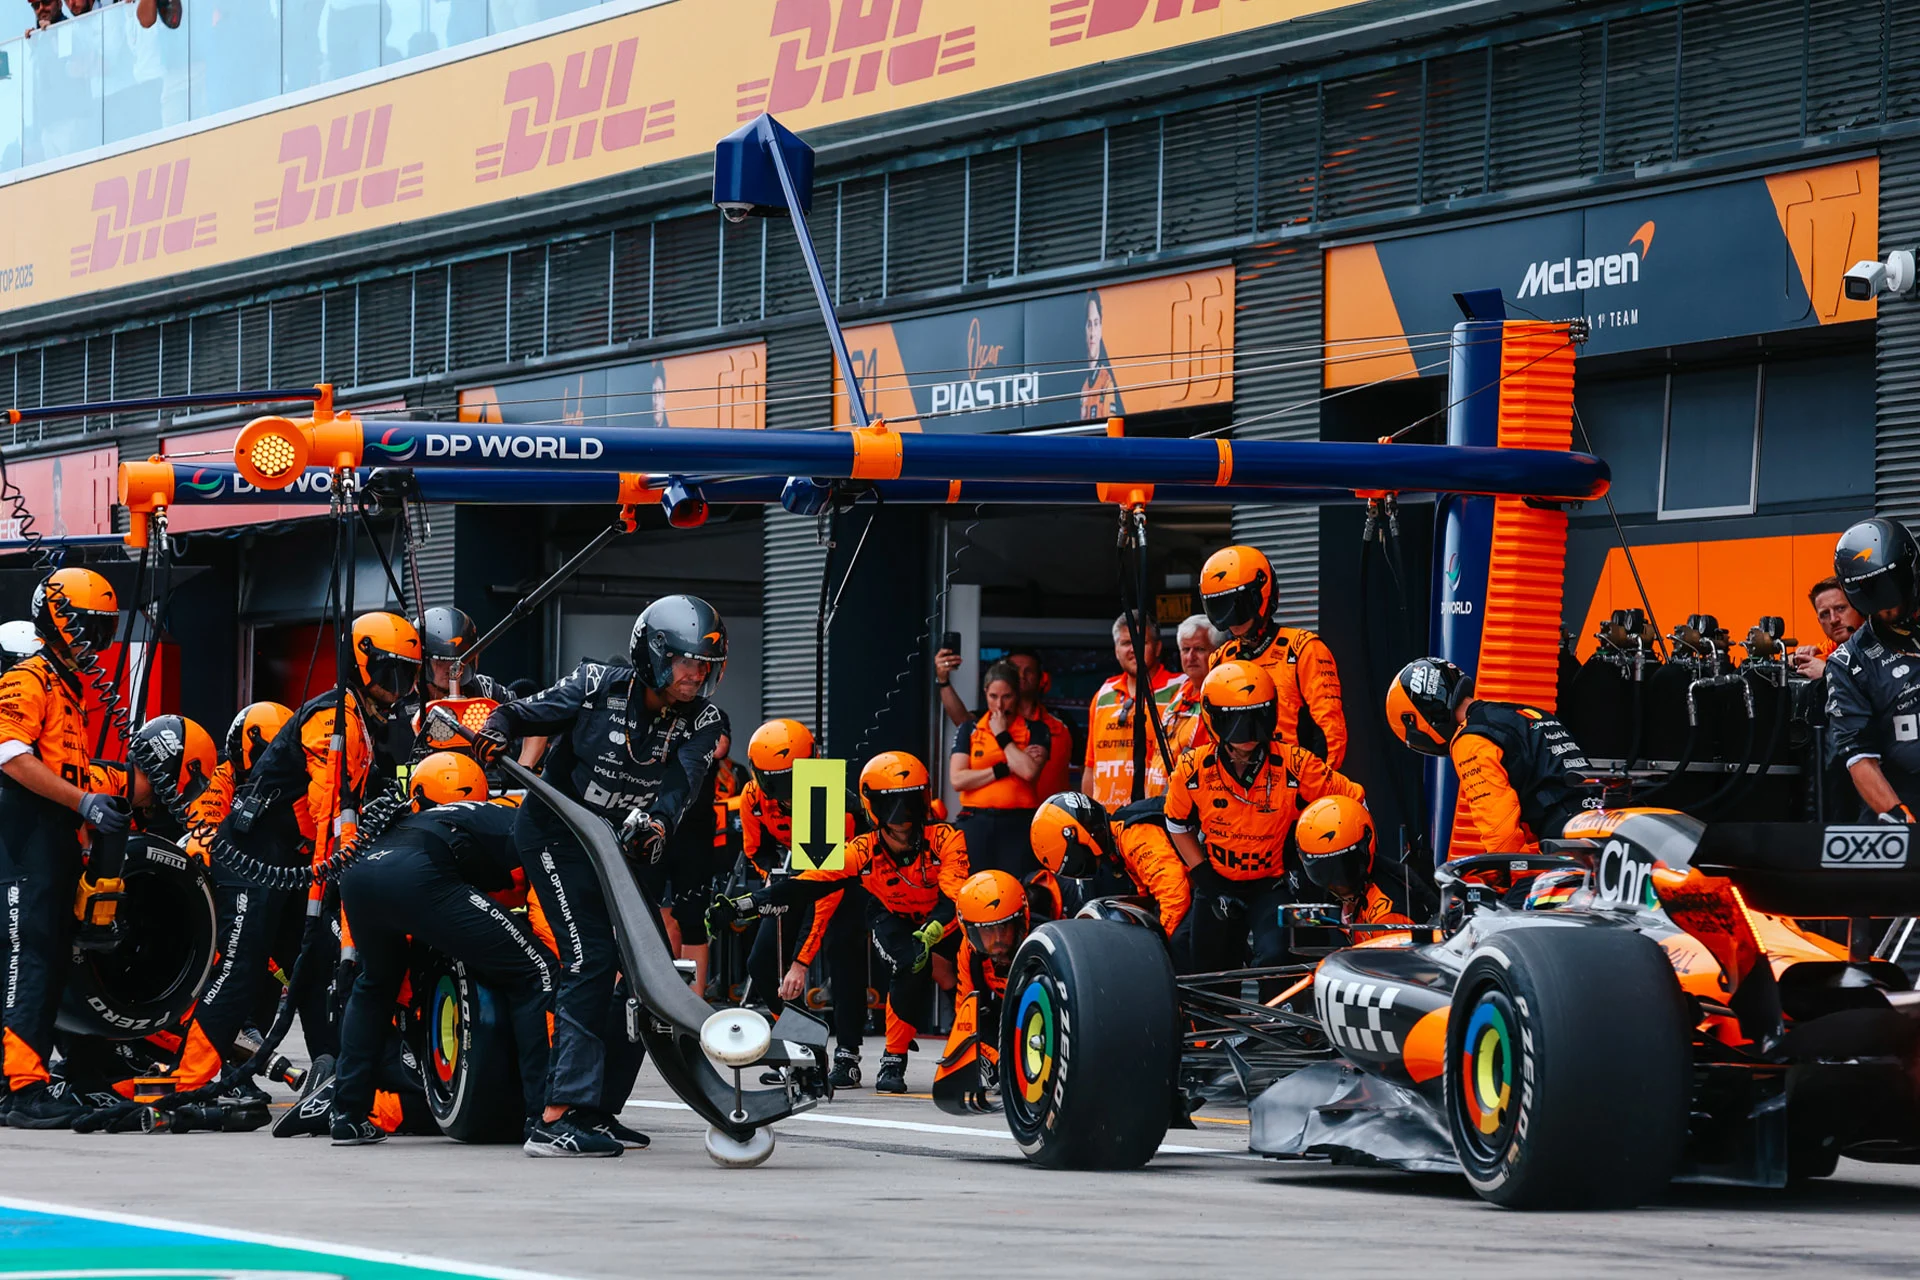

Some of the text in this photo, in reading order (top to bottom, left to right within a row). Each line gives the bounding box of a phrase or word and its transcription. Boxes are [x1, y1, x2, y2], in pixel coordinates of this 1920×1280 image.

[497, 37, 652, 179] DHL
[272, 104, 402, 231] DHL
[86, 158, 200, 273] DHL
[15, 264, 34, 289] 2025
[1517, 252, 1639, 299] McLaren
[1609, 309, 1638, 327] TEAM
[932, 372, 1039, 419] PIASTRI
[426, 434, 604, 460] DP WORLD
[1096, 761, 1124, 778] PIT
[146, 846, 187, 871] PIRELLI
[1827, 835, 1905, 860] OXXO
[1600, 840, 1656, 906] Chr
[550, 873, 573, 922] OPTIMUM
[9, 908, 20, 952] OPTIMUM
[226, 915, 244, 958] OPTIMUM
[490, 908, 528, 948] OPTIMUM
[524, 945, 552, 992] NUTRITION
[6, 955, 19, 1008] NUTRITION
[203, 959, 234, 1005] NUTRITION
[87, 996, 151, 1030] ZERO
[1053, 976, 1071, 1109] P ZERO
[1515, 995, 1535, 1141] P ZERO
